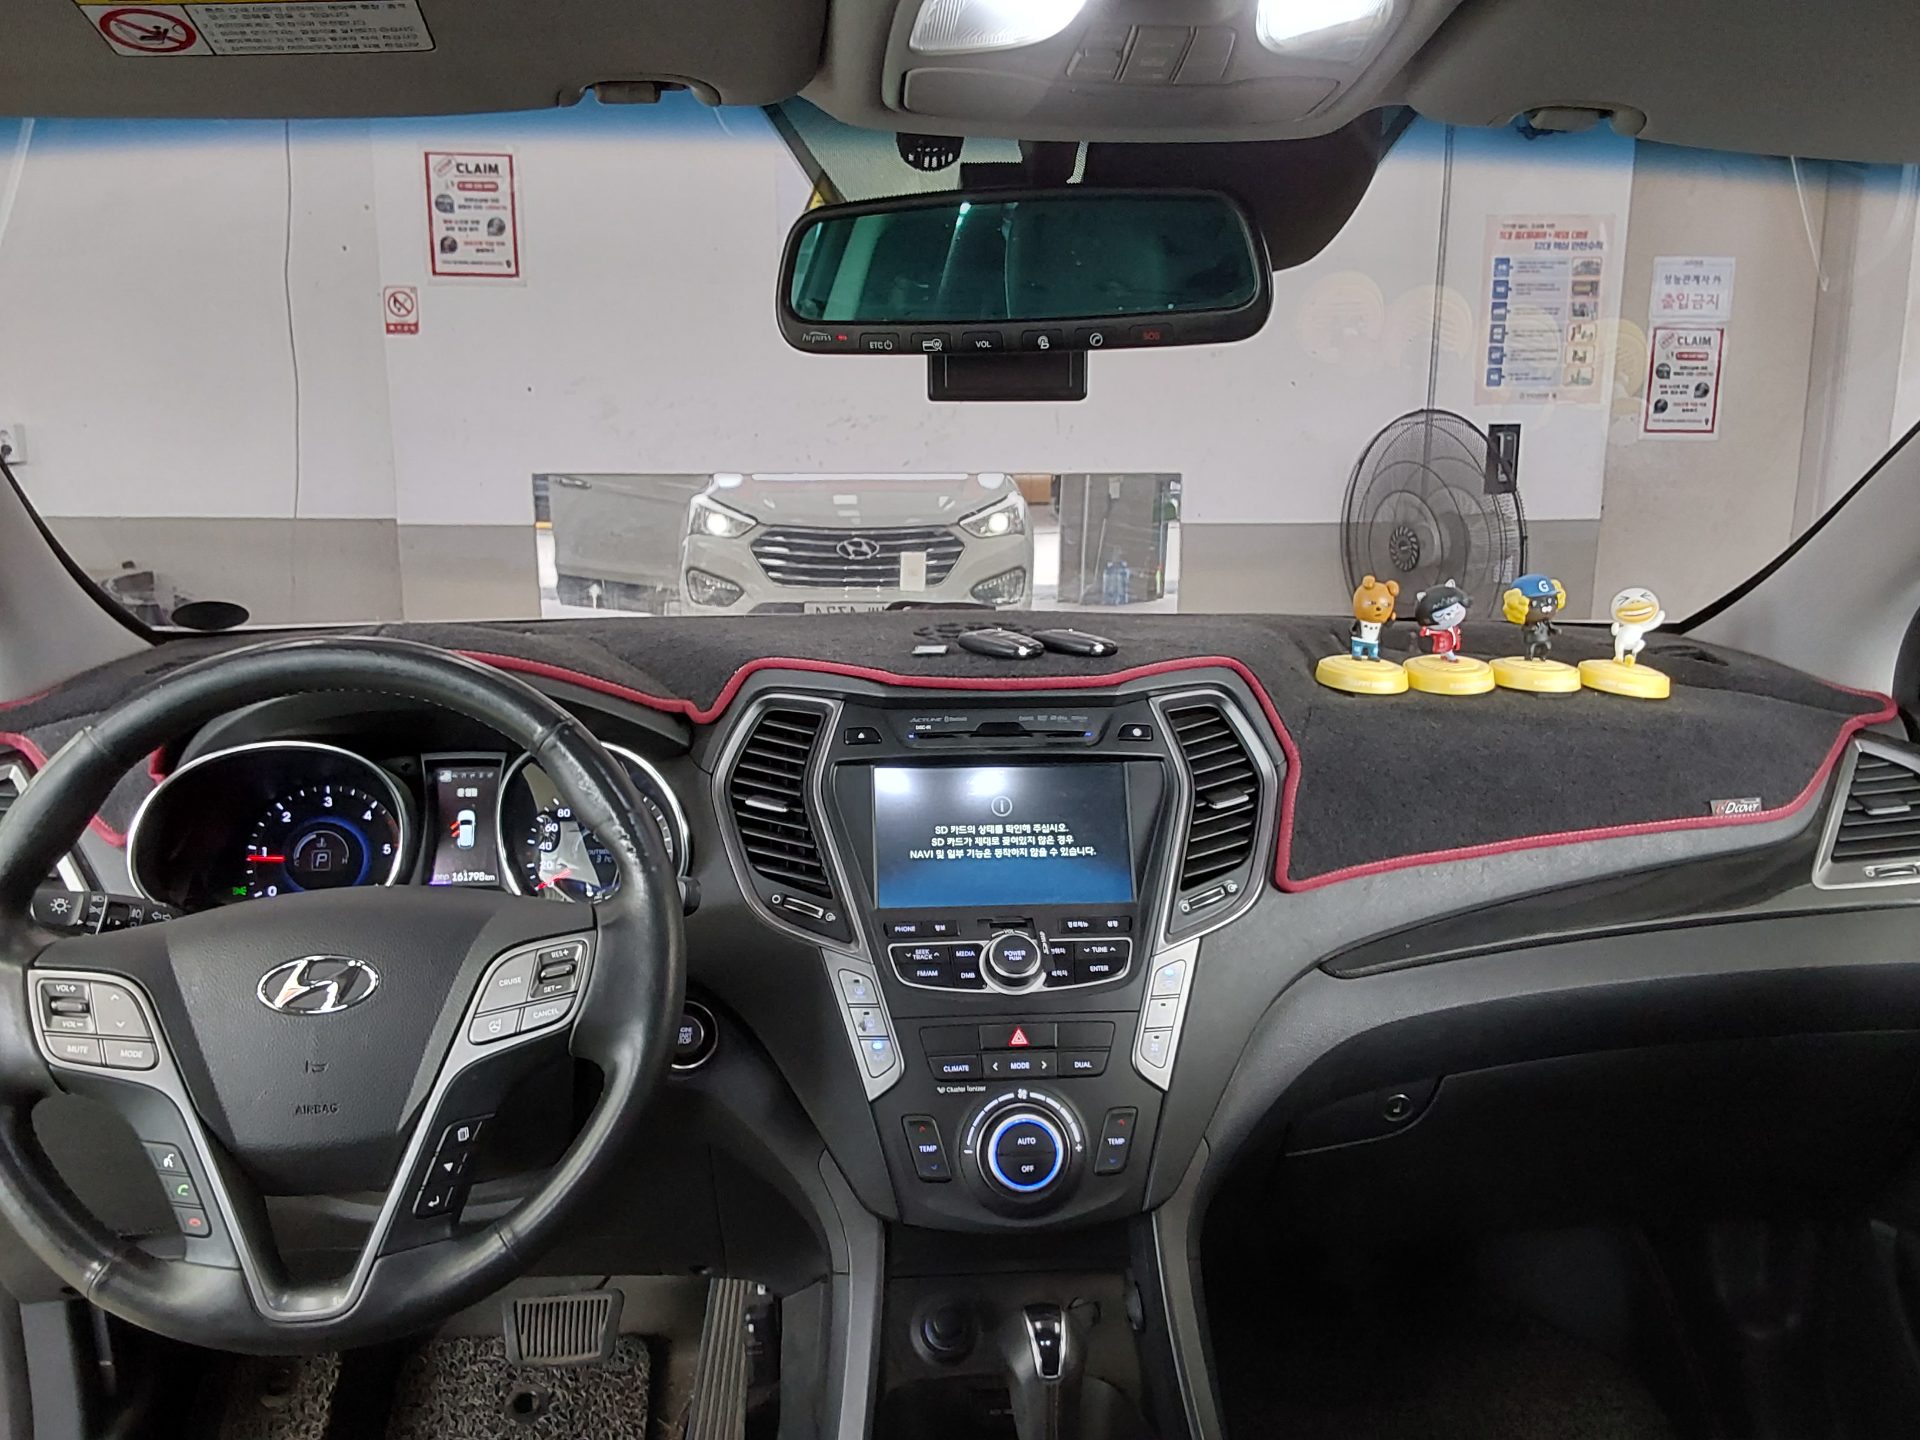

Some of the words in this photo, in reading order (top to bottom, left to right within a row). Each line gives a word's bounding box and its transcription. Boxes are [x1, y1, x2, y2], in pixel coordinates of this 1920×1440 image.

[456, 163, 499, 175] CLAIM
[1661, 293, 1720, 310] 출입금지
[1143, 332, 1160, 341] SOS
[1677, 336, 1712, 346] CLAIM
[869, 341, 884, 349] ETC
[975, 340, 992, 348] VOL
[1538, 580, 1549, 593] G
[324, 796, 333, 808] 3
[282, 811, 292, 823] 2
[363, 810, 372, 821] 4
[557, 808, 571, 818] 80
[544, 823, 559, 832] 60
[935, 825, 949, 834] SD
[950, 825, 976, 835] 카드의
[978, 824, 1004, 835] 상태를
[1005, 824, 1031, 834] 확인해
[1033, 823, 1069, 833] 주십시오.
[931, 837, 945, 847] SD
[946, 837, 973, 847] 카드가
[975, 837, 1000, 846] 제대로
[1037, 835, 1055, 845] 않은
[1057, 834, 1074, 845] 경우
[382, 844, 391, 855] 5
[539, 841, 553, 851] 40
[909, 849, 934, 859] NAVI
[935, 849, 945, 859] 및
[946, 848, 964, 859] 일부
[966, 848, 992, 859] 기능은
[994, 847, 1028, 858] 동작하지
[1029, 847, 1048, 857] 않을
[1049, 847, 1059, 857] 수
[1060, 846, 1097, 857] 있습니다.
[315, 857, 328, 868] P
[267, 886, 277, 897] 0
[499, 976, 522, 987] CRUISE
[533, 1008, 559, 1019] CANCEL
[67, 1045, 89, 1054] MUTE
[120, 1049, 144, 1058] MODE
[943, 1065, 970, 1073] CLIMATE
[1010, 1062, 1030, 1070] MODE
[295, 1103, 339, 1115] AIRBAG
[1017, 1137, 1036, 1146] AUTO
[1107, 1137, 1126, 1146] TEMP
[919, 1145, 938, 1153] TEMP
[1021, 1165, 1035, 1173] OFF
